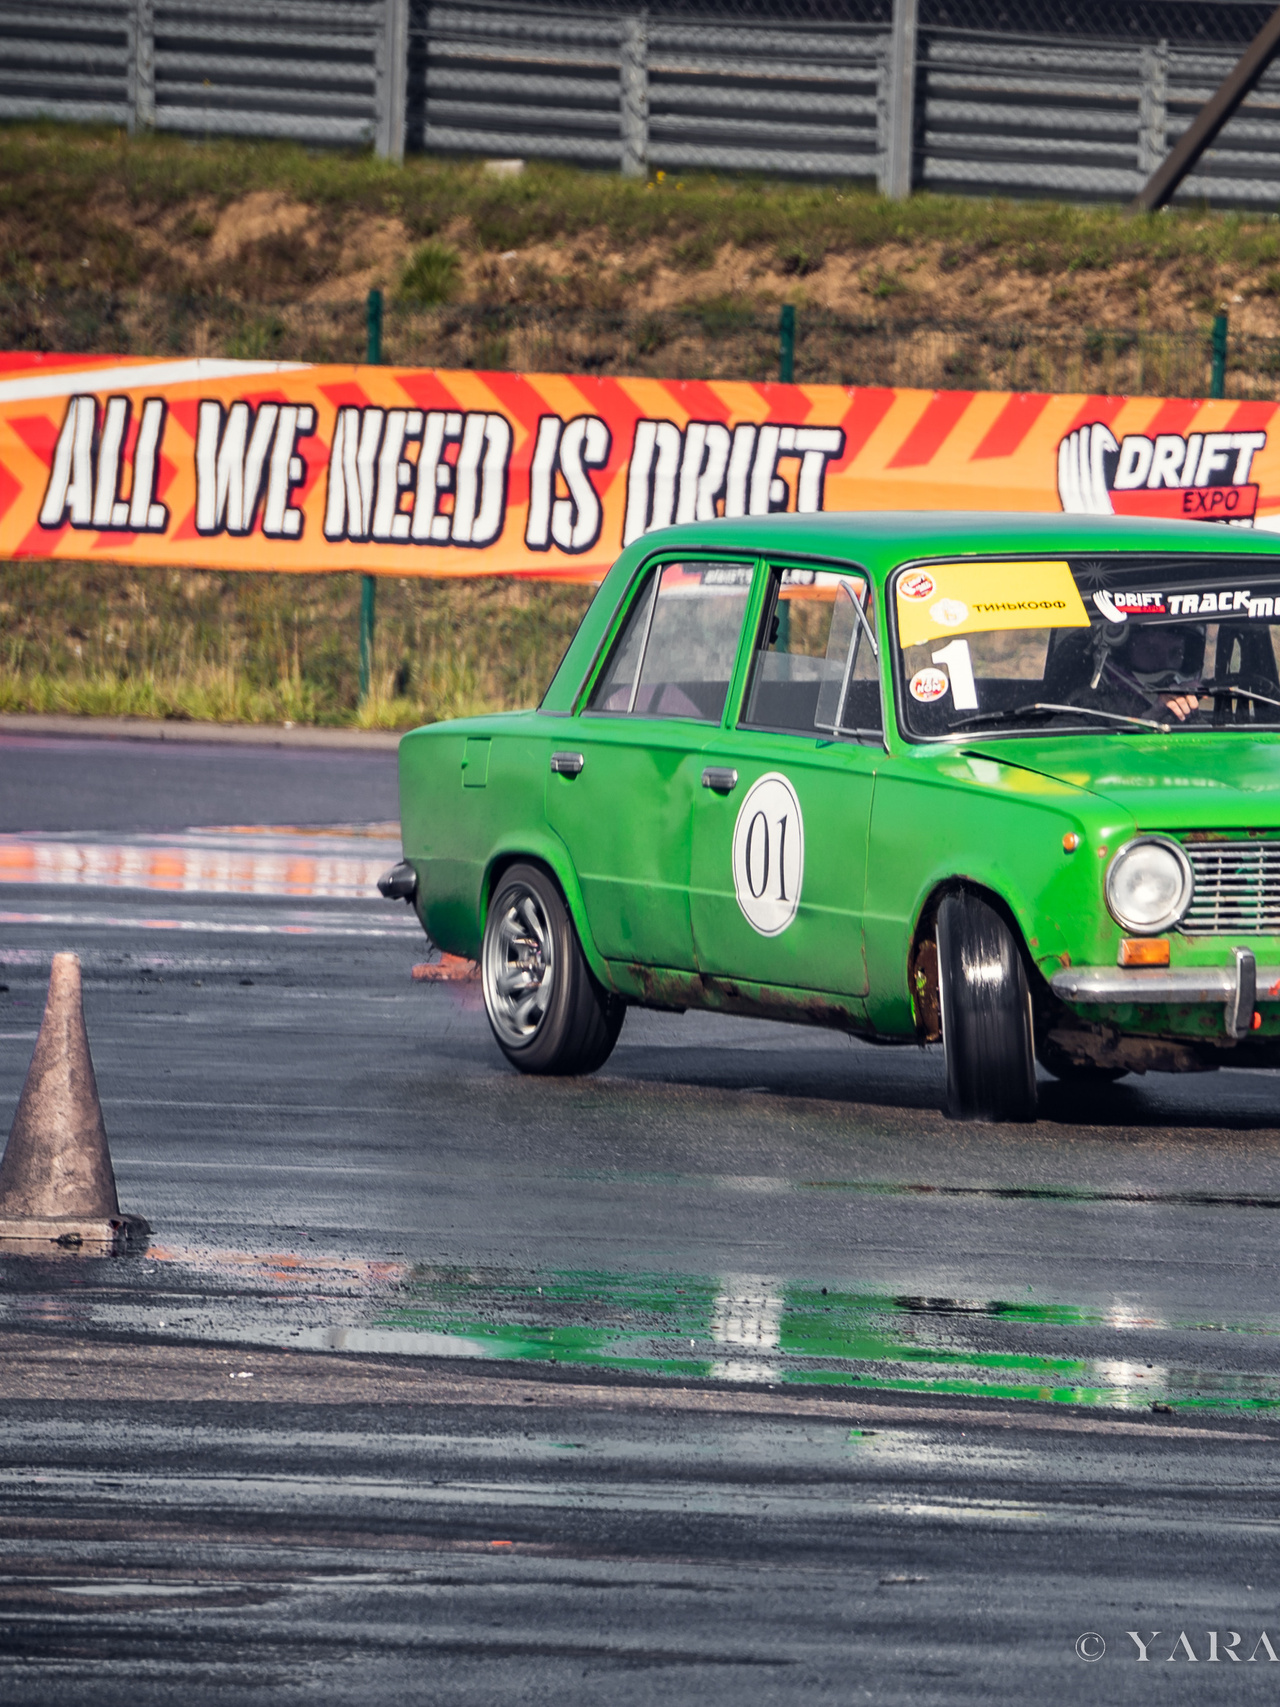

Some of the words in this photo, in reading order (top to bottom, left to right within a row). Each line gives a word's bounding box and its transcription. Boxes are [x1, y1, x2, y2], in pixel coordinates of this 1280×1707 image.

[37, 395, 169, 532] ALL
[195, 399, 316, 540] WE
[323, 403, 512, 549] NEED
[525, 413, 611, 554] IS
[621, 418, 846, 549] DRIFT
[1113, 430, 1267, 490] DRIFT
[1183, 490, 1239, 512] EXPO
[973, 600, 1067, 613] ТИНЬКОФФ
[1114, 592, 1163, 607] DRIFT
[1167, 590, 1251, 615] TRACK
[931, 639, 979, 711] 1
[745, 810, 790, 902] 01
